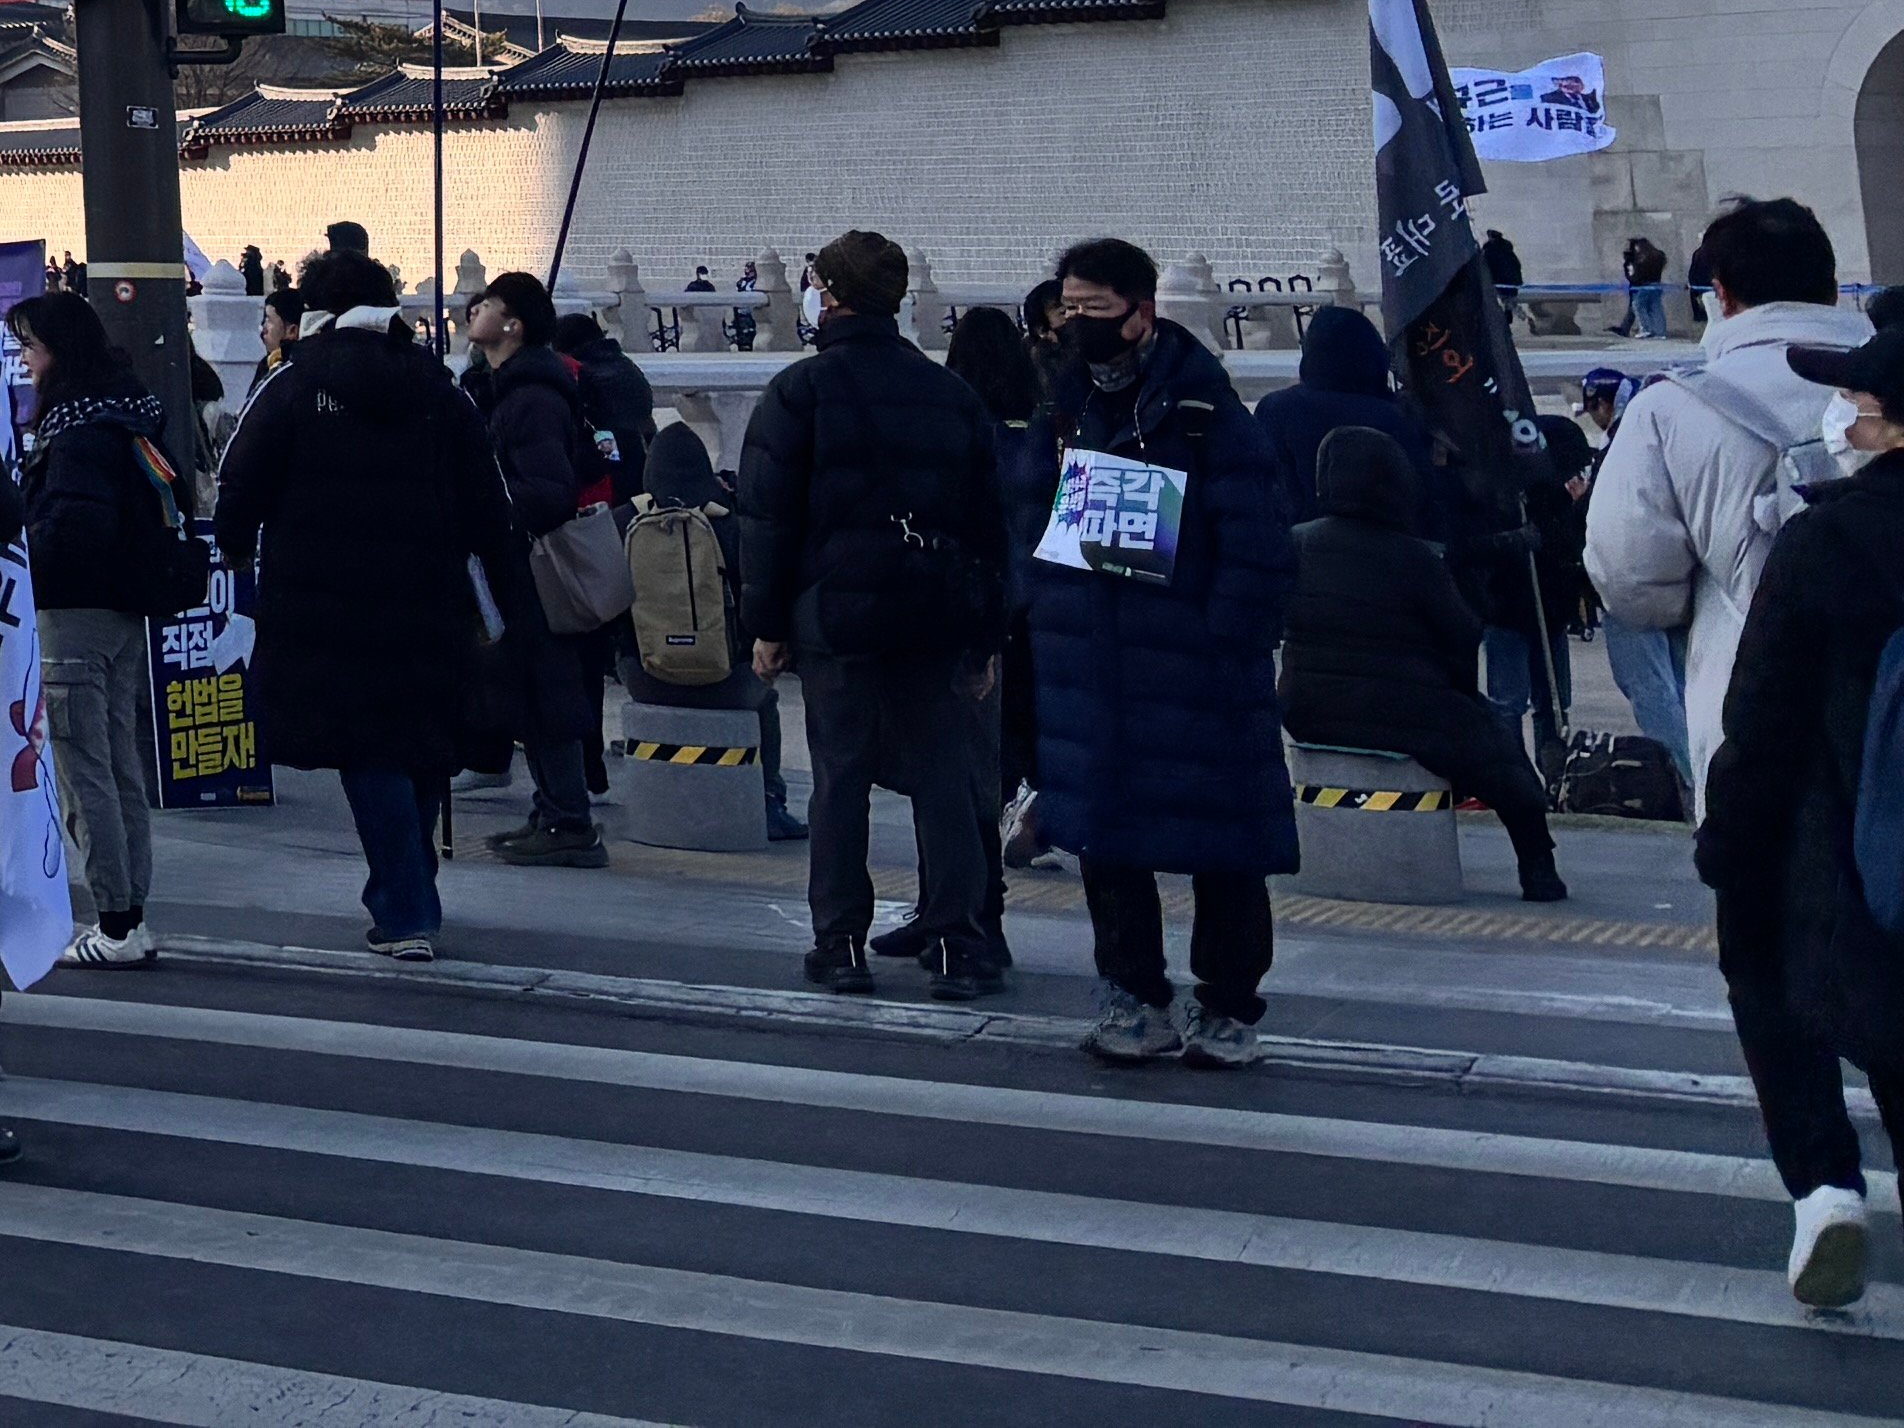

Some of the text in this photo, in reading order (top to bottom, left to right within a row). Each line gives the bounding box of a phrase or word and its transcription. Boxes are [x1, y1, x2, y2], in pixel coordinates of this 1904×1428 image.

[1086, 468, 1166, 511] 즉각
[1080, 508, 1159, 551] 파면
[162, 619, 213, 671] 직접
[166, 673, 244, 729] 헌법을
